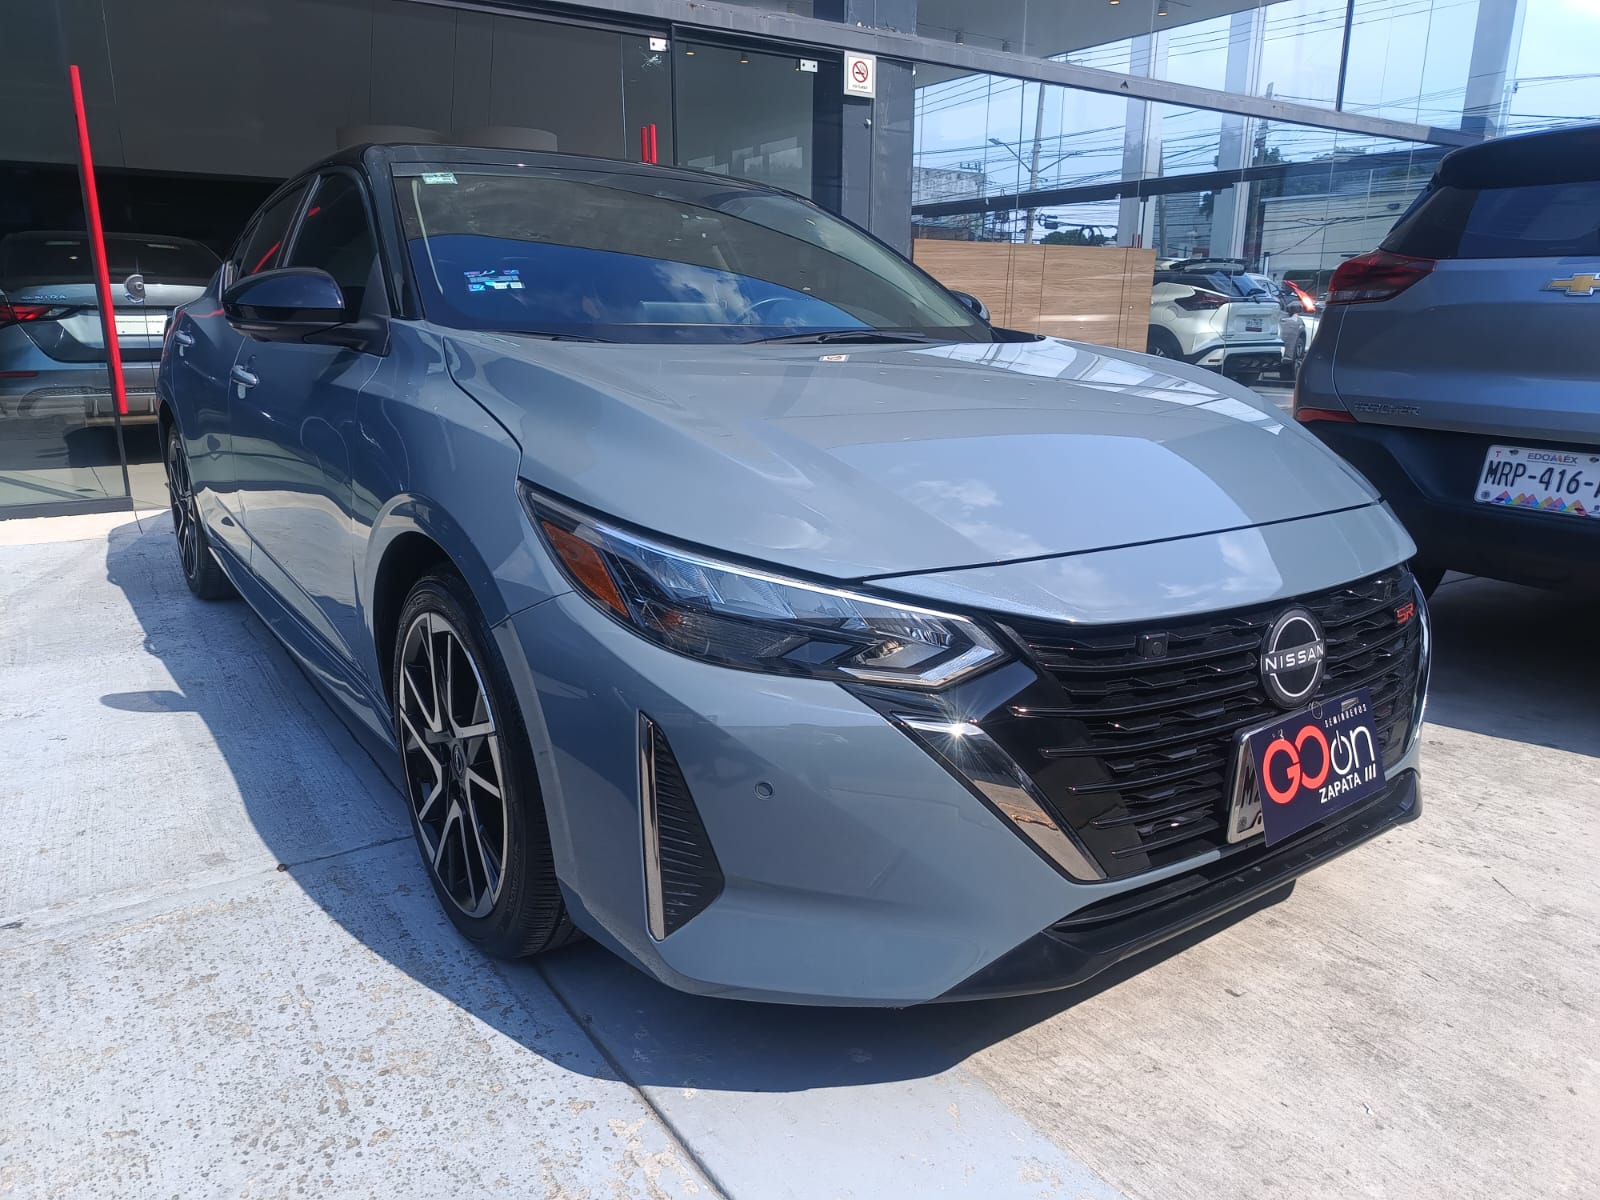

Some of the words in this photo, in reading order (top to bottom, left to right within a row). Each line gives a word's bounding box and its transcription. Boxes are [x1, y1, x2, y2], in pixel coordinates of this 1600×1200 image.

[1483, 459, 1600, 499] MRP-416-
[1264, 643, 1323, 671] NISSAN
[1319, 772, 1362, 804] ZAPATA
